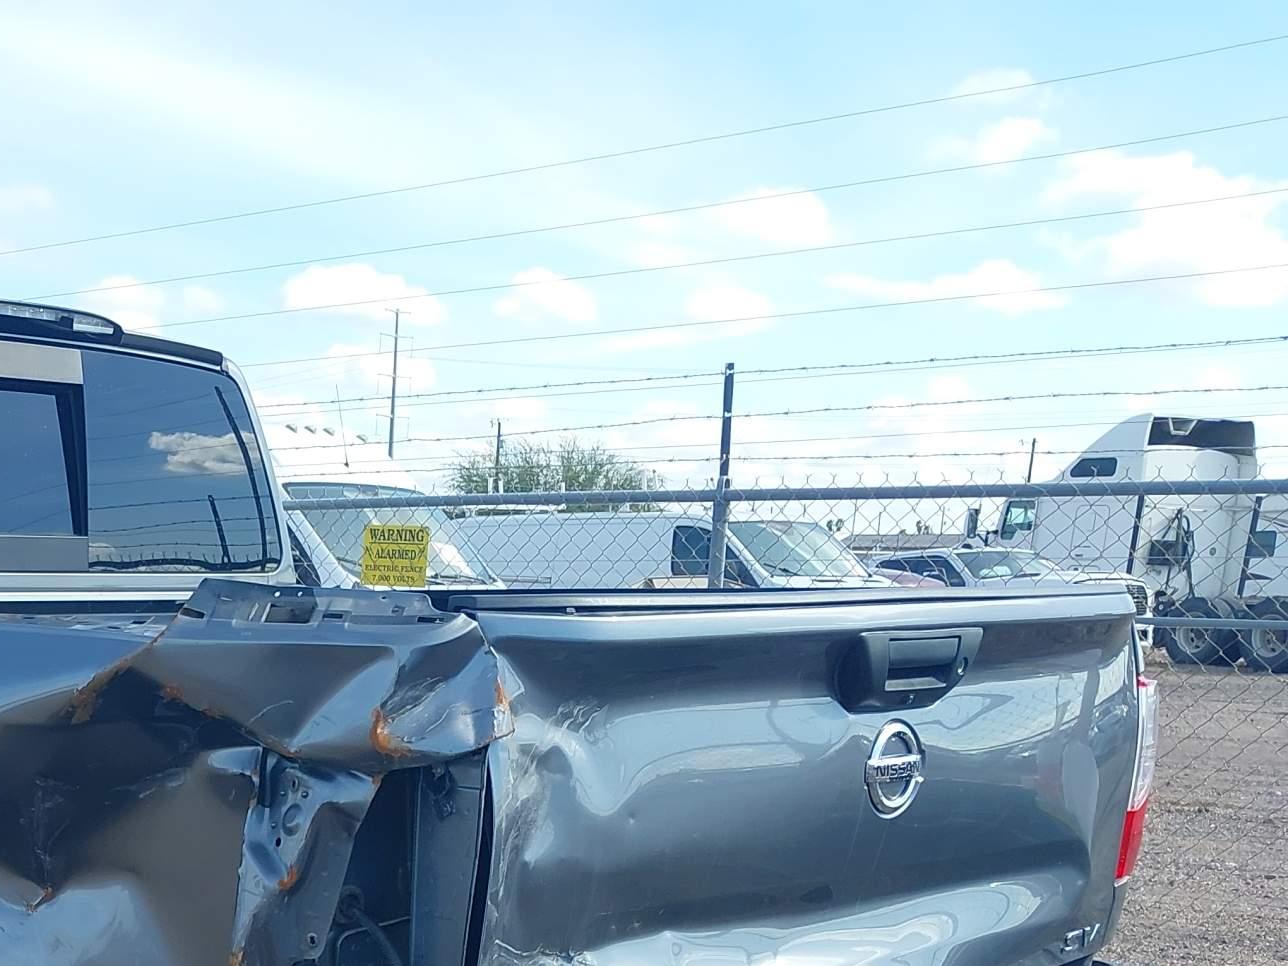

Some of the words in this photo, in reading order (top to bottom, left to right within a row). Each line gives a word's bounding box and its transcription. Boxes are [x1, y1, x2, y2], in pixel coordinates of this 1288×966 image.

[369, 528, 424, 542] WARNING
[374, 548, 417, 560] ALARMED
[365, 564, 399, 573] ELECTRIC
[401, 565, 424, 573] FENCE
[392, 575, 416, 583] VOLTS
[875, 761, 921, 777] NISSAN
